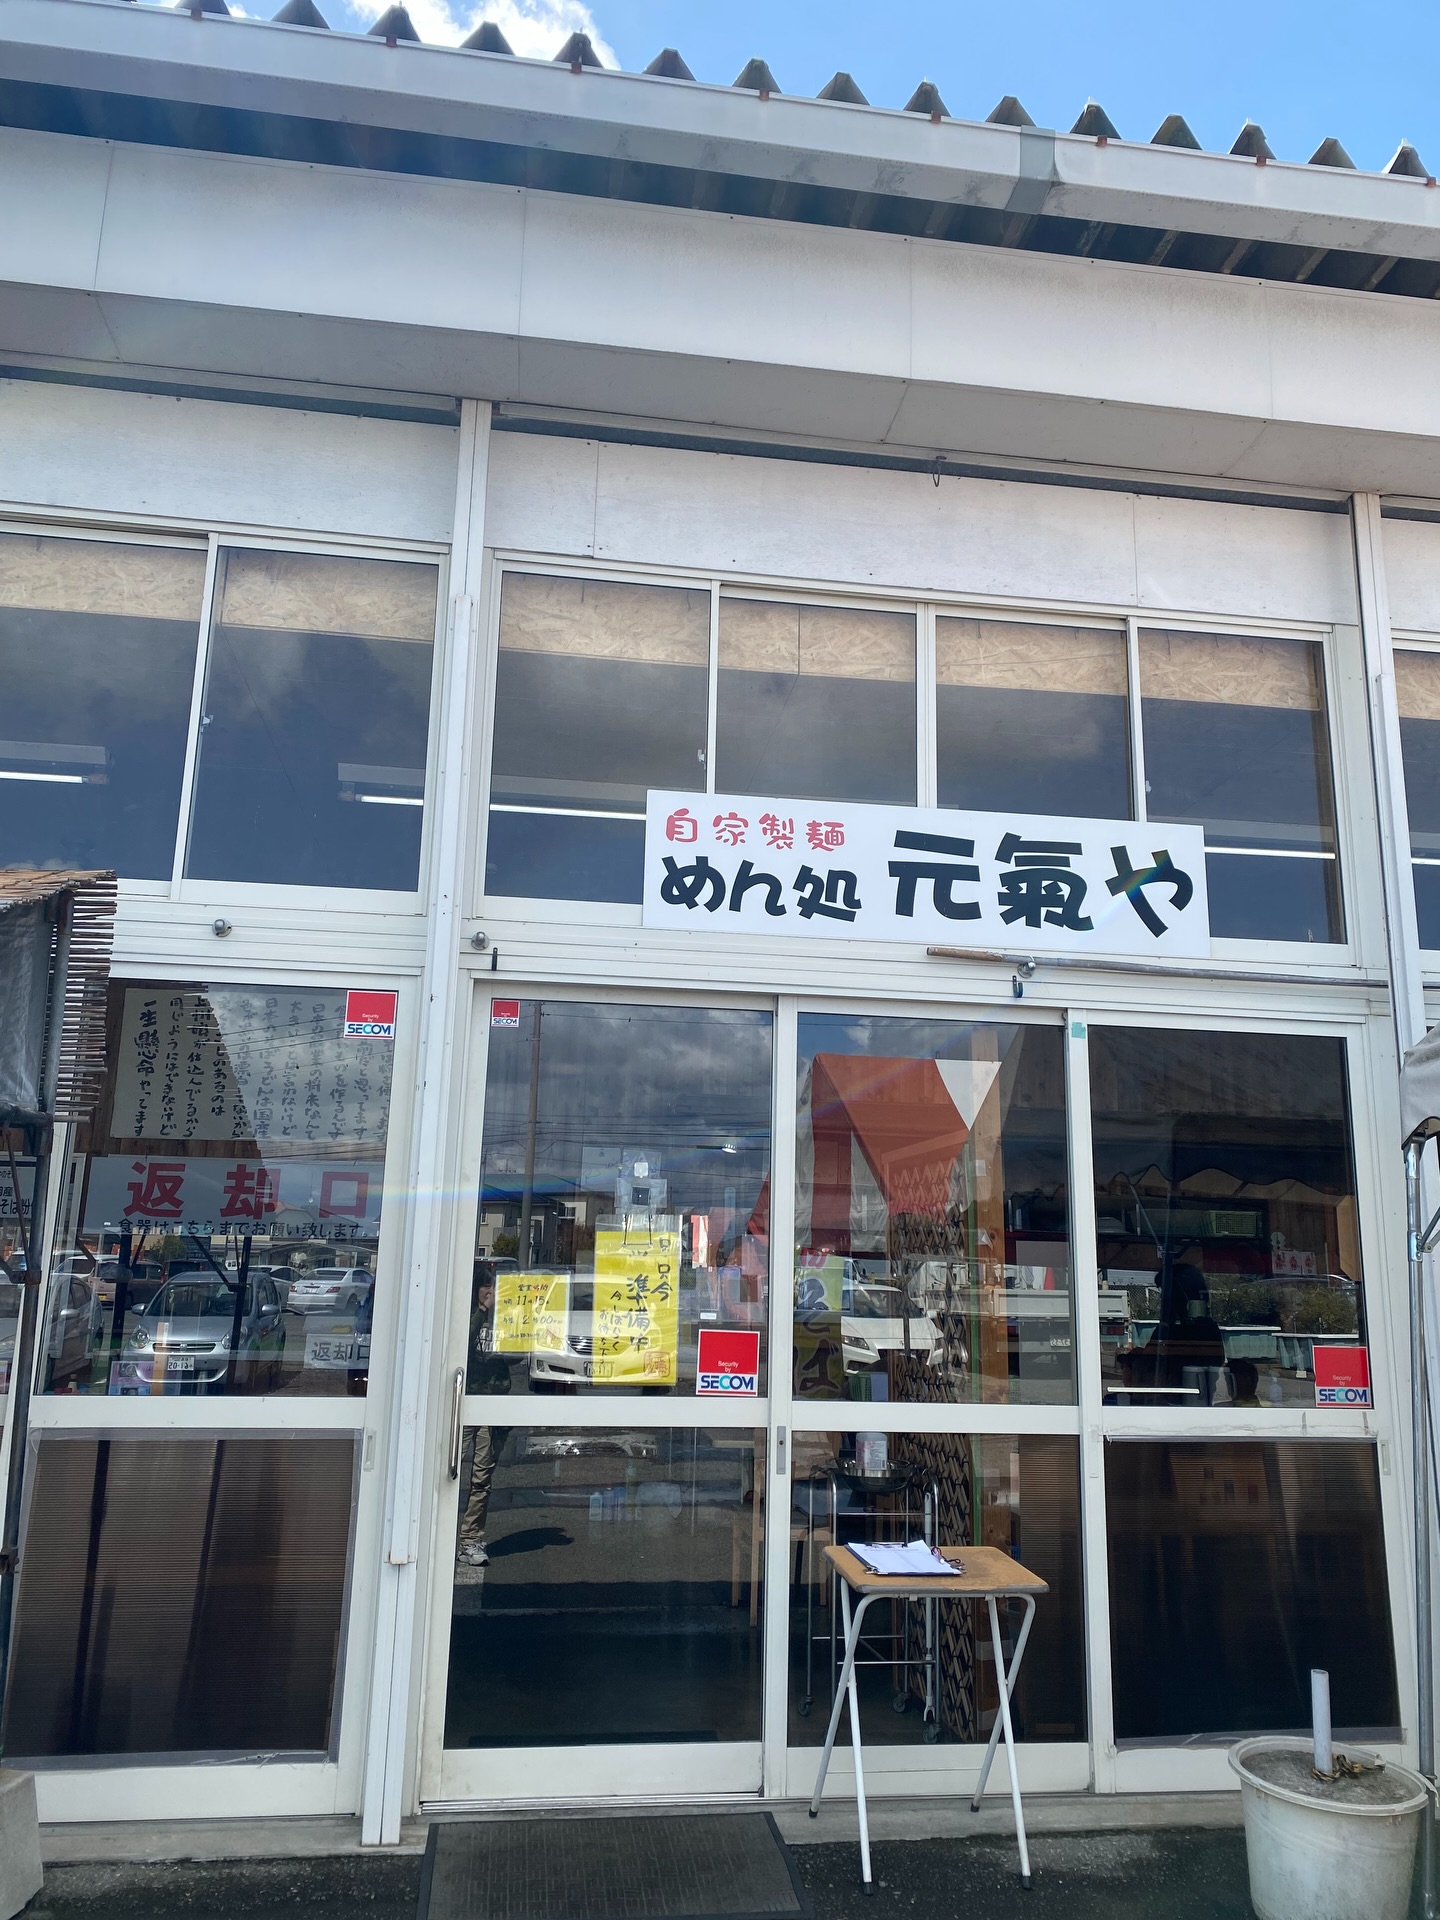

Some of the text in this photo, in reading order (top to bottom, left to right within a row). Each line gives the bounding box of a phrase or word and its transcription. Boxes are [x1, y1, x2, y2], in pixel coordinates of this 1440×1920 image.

[666, 808, 845, 852] 自家製麺
[660, 829, 1194, 938] めん処 元氣や
[347, 1023, 392, 1036] SECOM
[493, 1017, 518, 1025] SECOM
[133, 1000, 160, 1136] 一生懸命やってます
[159, 998, 184, 1136] 同じようにはできないけど
[123, 1161, 370, 1219] 返却口
[717, 1360, 739, 1368] Security
[700, 1374, 754, 1390] SECOM
[1318, 1388, 1368, 1403] SECOM
